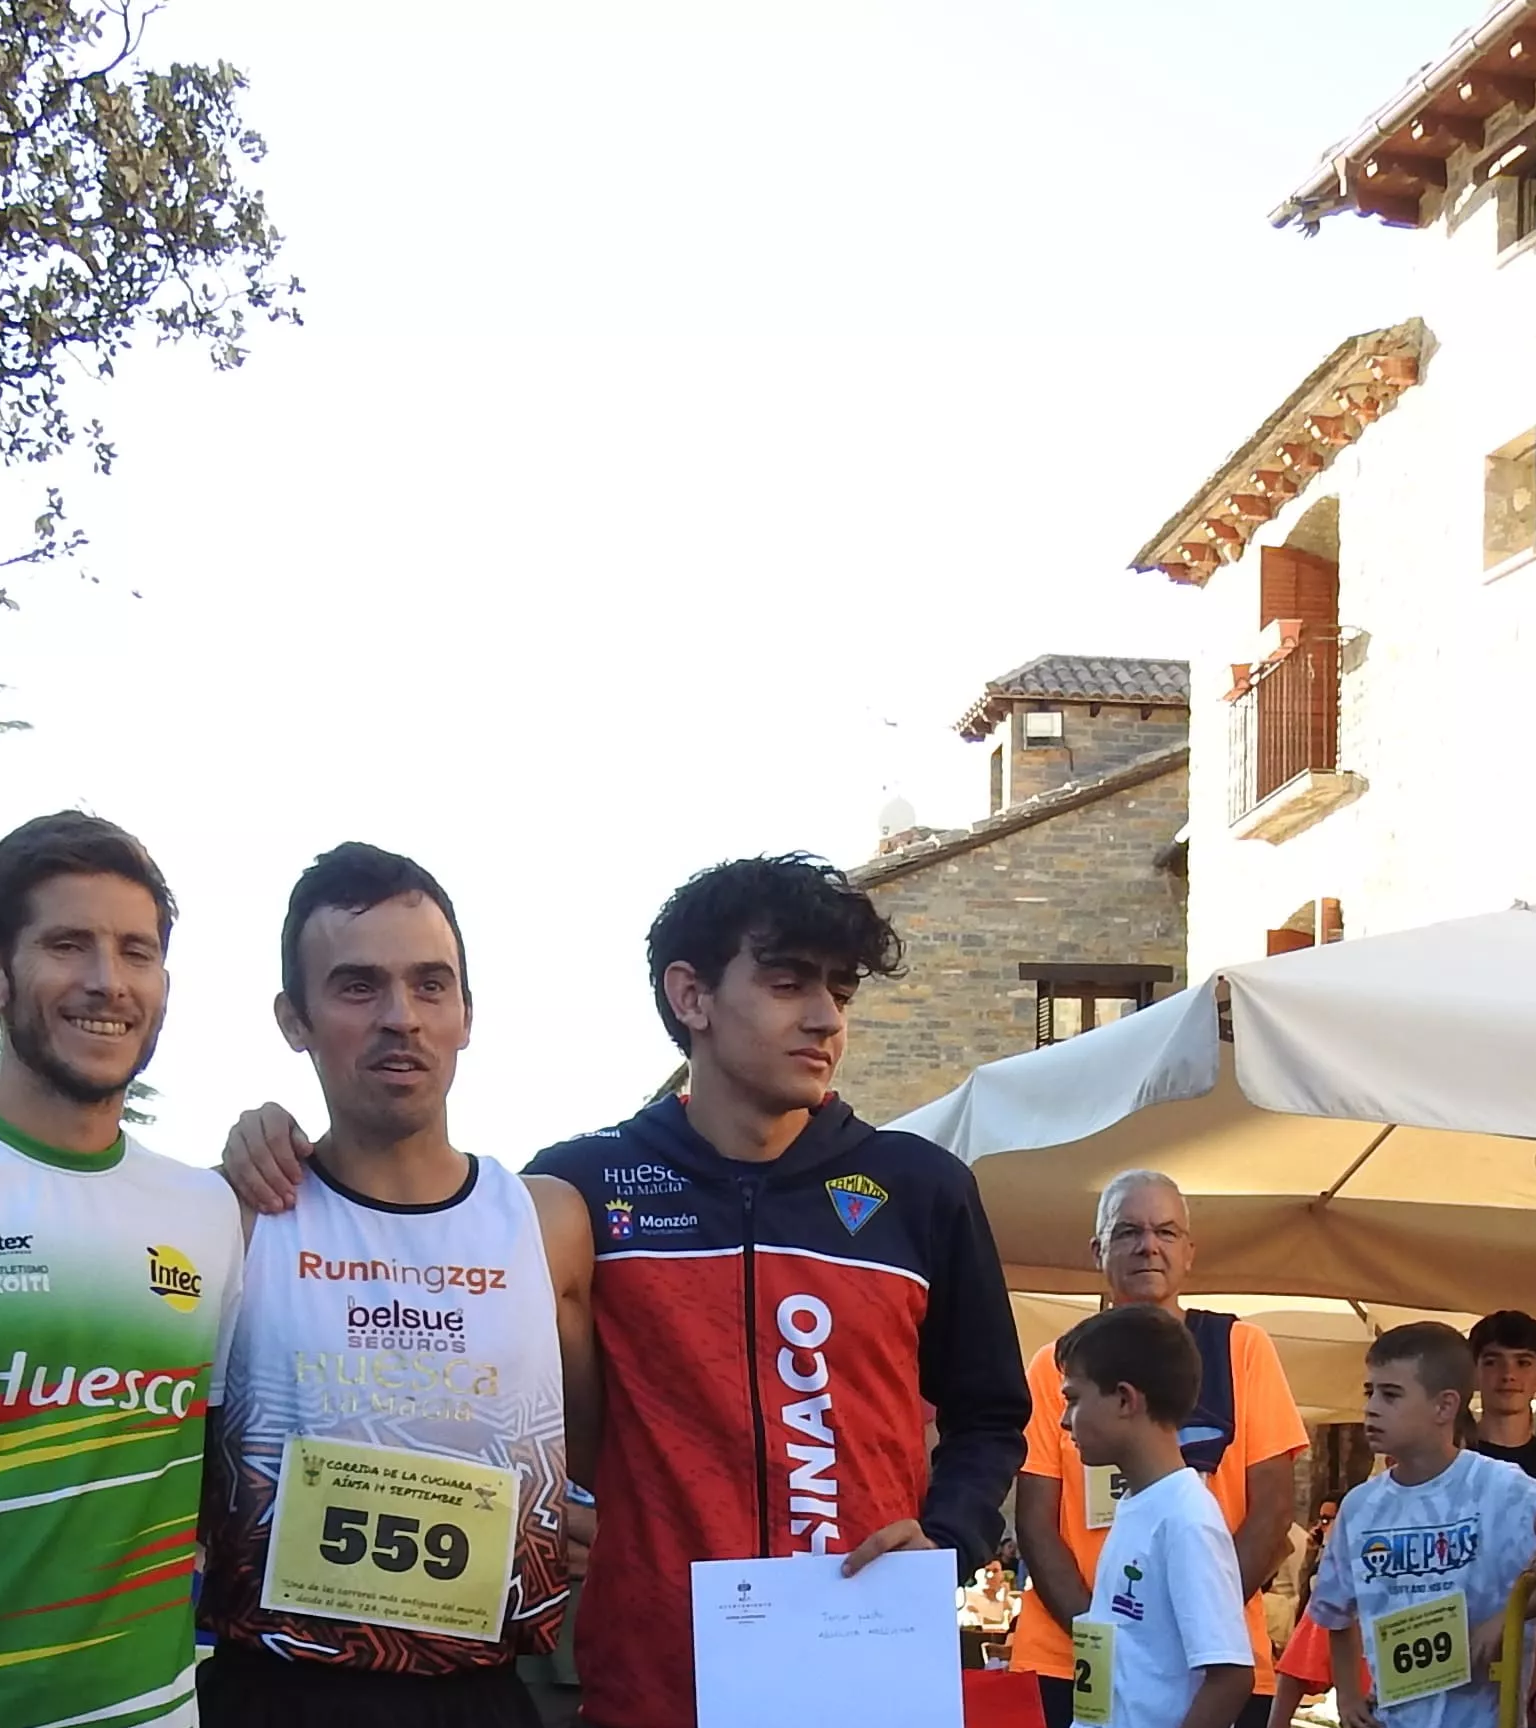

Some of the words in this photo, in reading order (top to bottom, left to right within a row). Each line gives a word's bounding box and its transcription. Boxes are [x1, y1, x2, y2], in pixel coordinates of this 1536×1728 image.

[640, 1213, 698, 1228] Monzón
[299, 1250, 507, 1296] Runningzgz
[347, 1335, 466, 1354] SEGUROS
[296, 1349, 500, 1398] Huesca
[326, 1460, 379, 1476] CORRIDA
[383, 1468, 398, 1479] DE
[402, 1471, 417, 1482] LA
[420, 1475, 473, 1491] CUCHARA
[390, 1485, 464, 1507] SEPTIEMBRE
[319, 1505, 470, 1581] 559
[1393, 1631, 1453, 1674] 699
